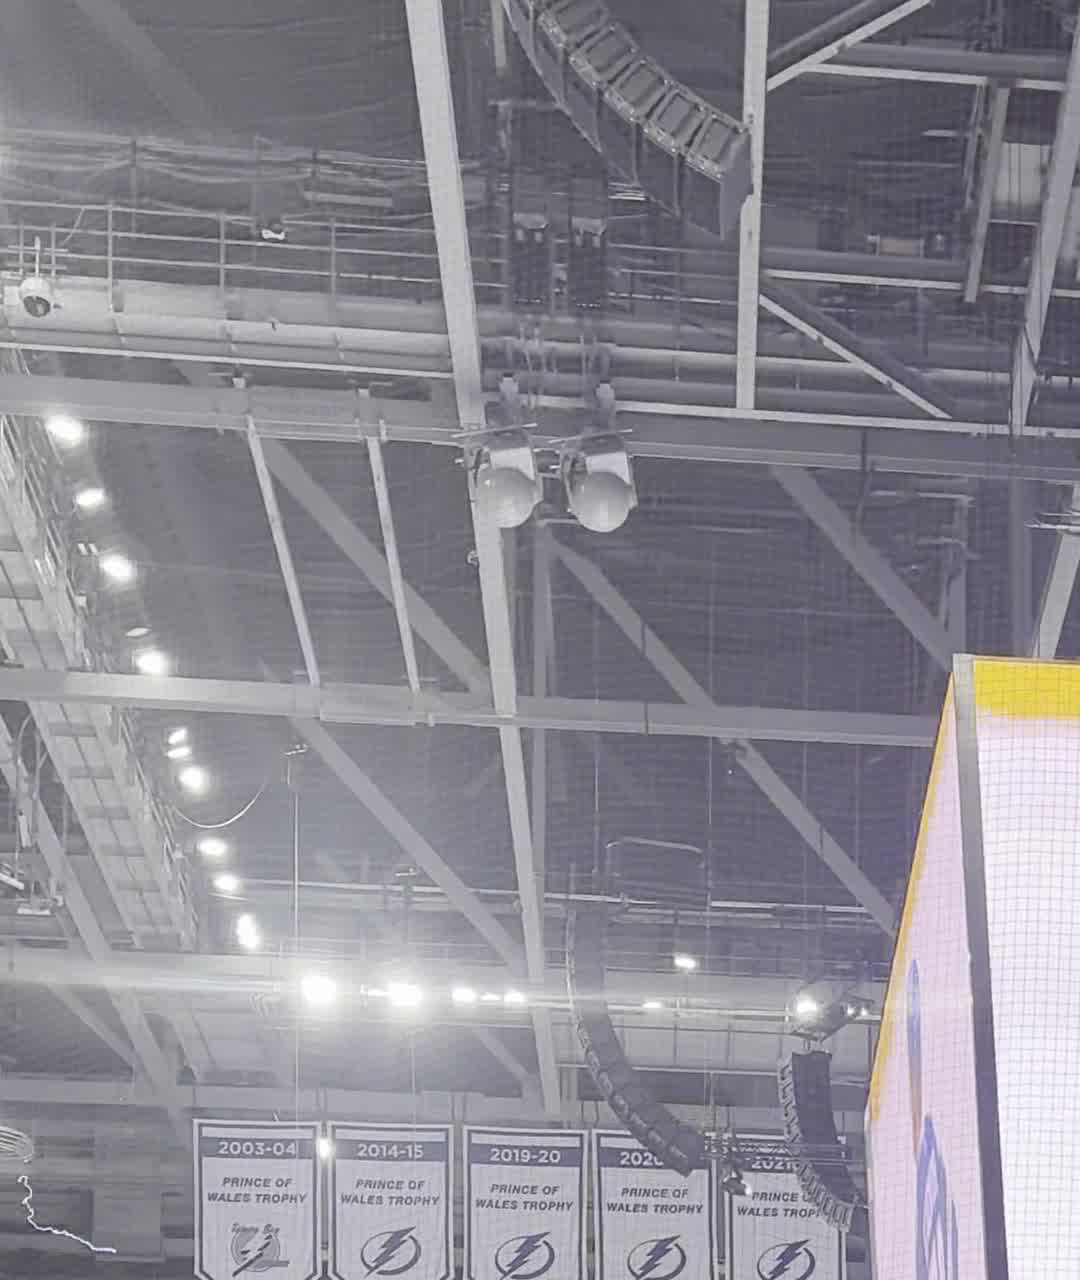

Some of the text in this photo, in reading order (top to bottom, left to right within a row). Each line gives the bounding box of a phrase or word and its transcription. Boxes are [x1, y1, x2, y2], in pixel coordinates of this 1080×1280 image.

[219, 1141, 297, 1156] 2003-04
[357, 1143, 424, 1159] 2014-15
[490, 1148, 561, 1164] 2019-20
[221, 1177, 293, 1188] PRINCE OF
[355, 1179, 426, 1191] PRINCE OF
[490, 1183, 560, 1196] PRINCE OF
[621, 1187, 690, 1199] PRINCE OF
[207, 1192, 308, 1205] WALES TROPHY
[340, 1194, 441, 1206] WALES TROPHY
[752, 1191, 799, 1203] PRINCE
[475, 1199, 574, 1212] WALES TROPHY
[607, 1203, 705, 1215] WALES TROPHY
[737, 1207, 820, 1219] WALES TROP
